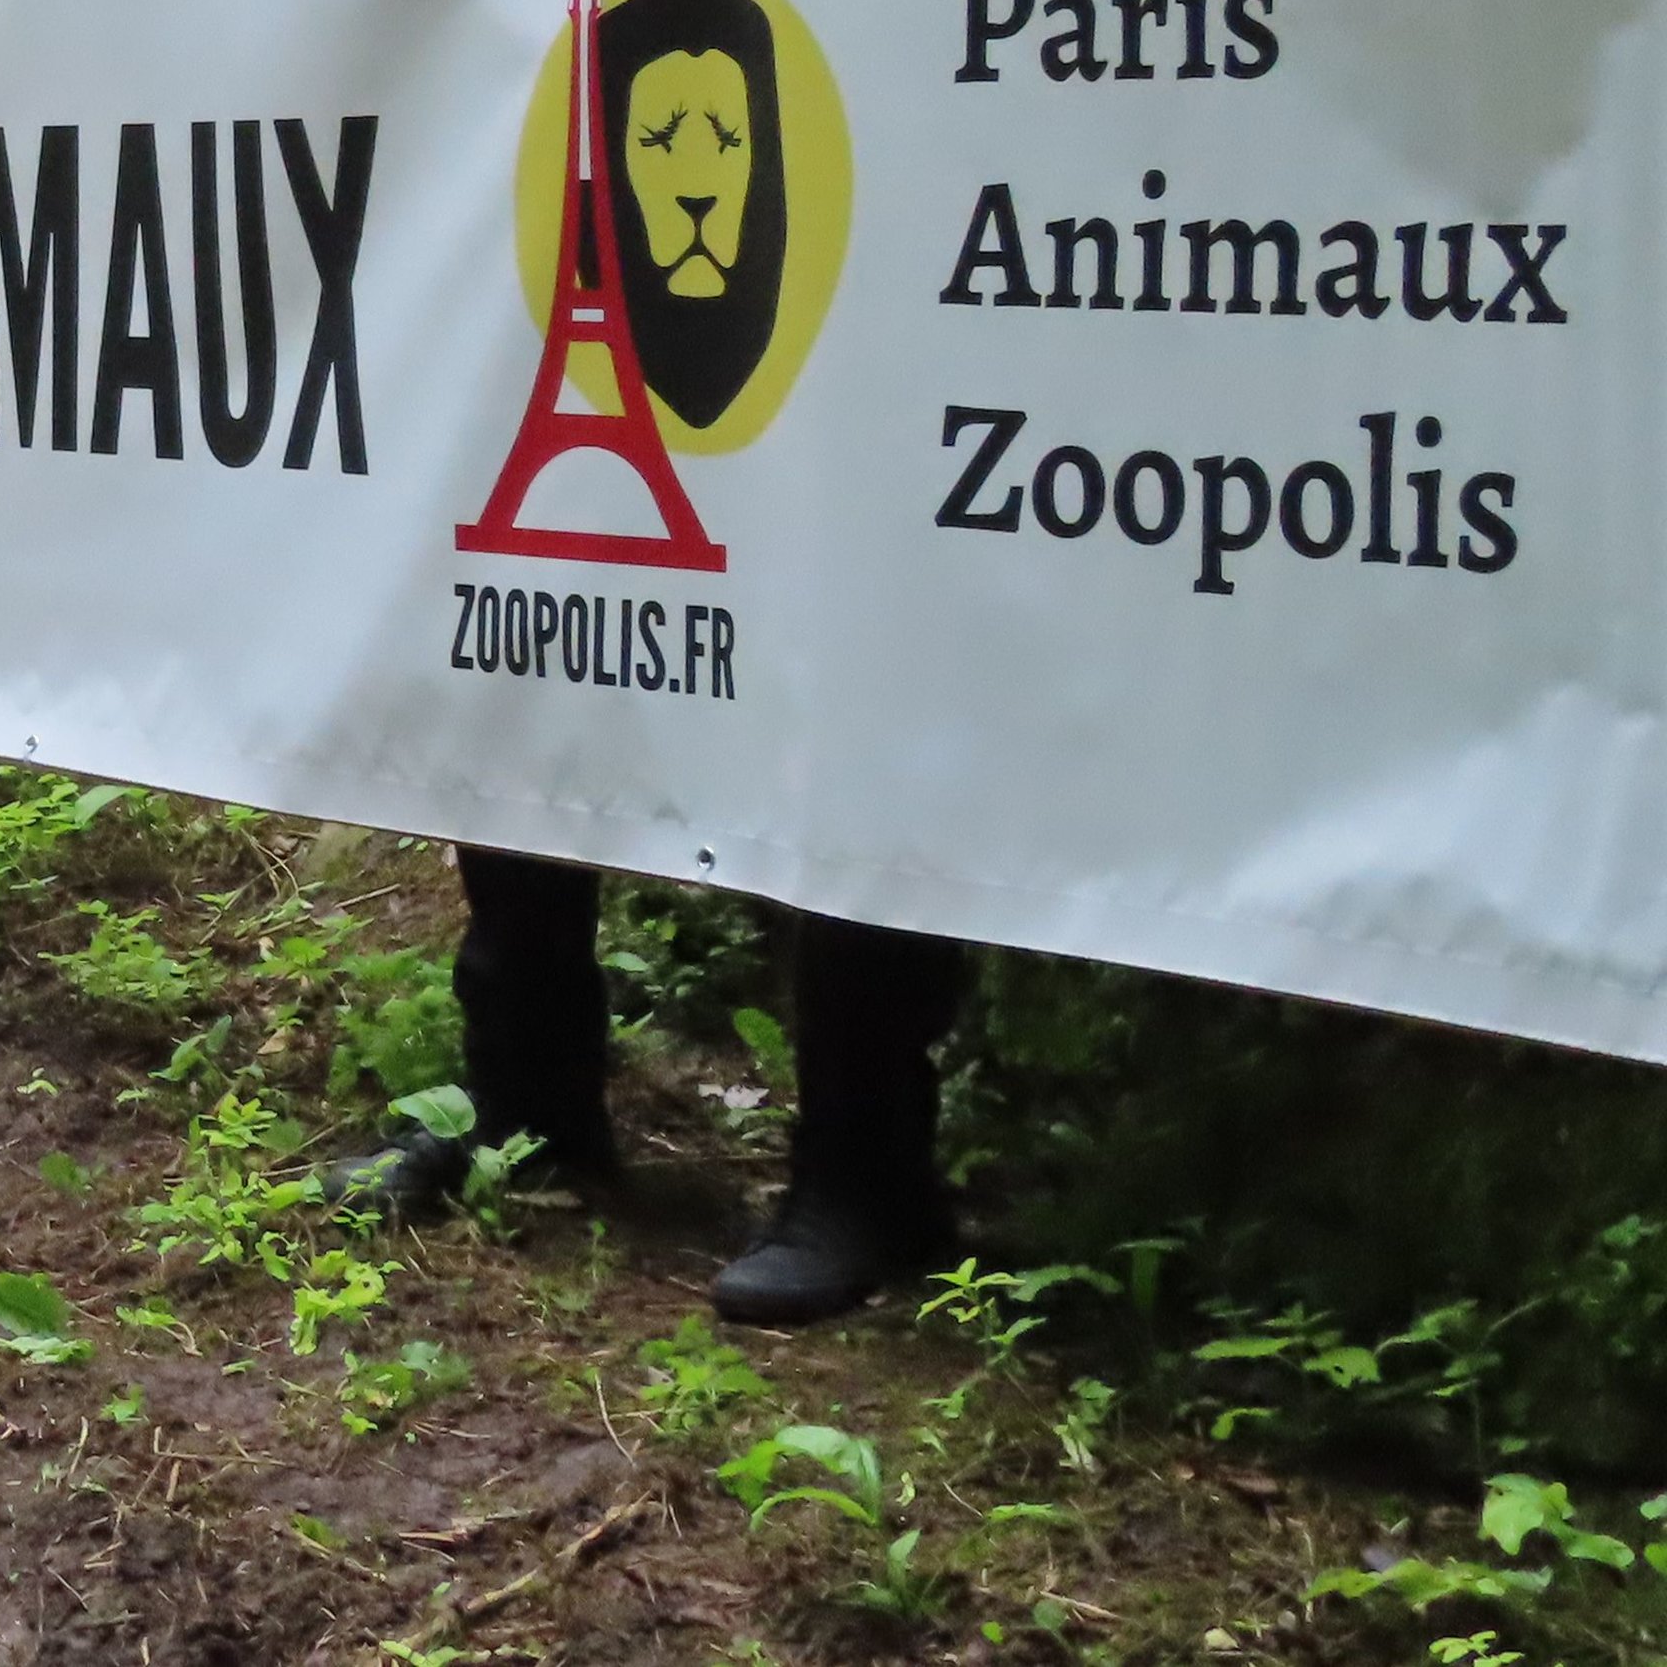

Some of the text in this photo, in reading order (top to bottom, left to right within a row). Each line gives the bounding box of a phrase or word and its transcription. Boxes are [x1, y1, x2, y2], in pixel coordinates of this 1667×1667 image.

[938, 169, 1569, 325] Animaux
[934, 405, 1519, 595] Zoopolis
[450, 582, 737, 701] ZOOPOLIS.FR
